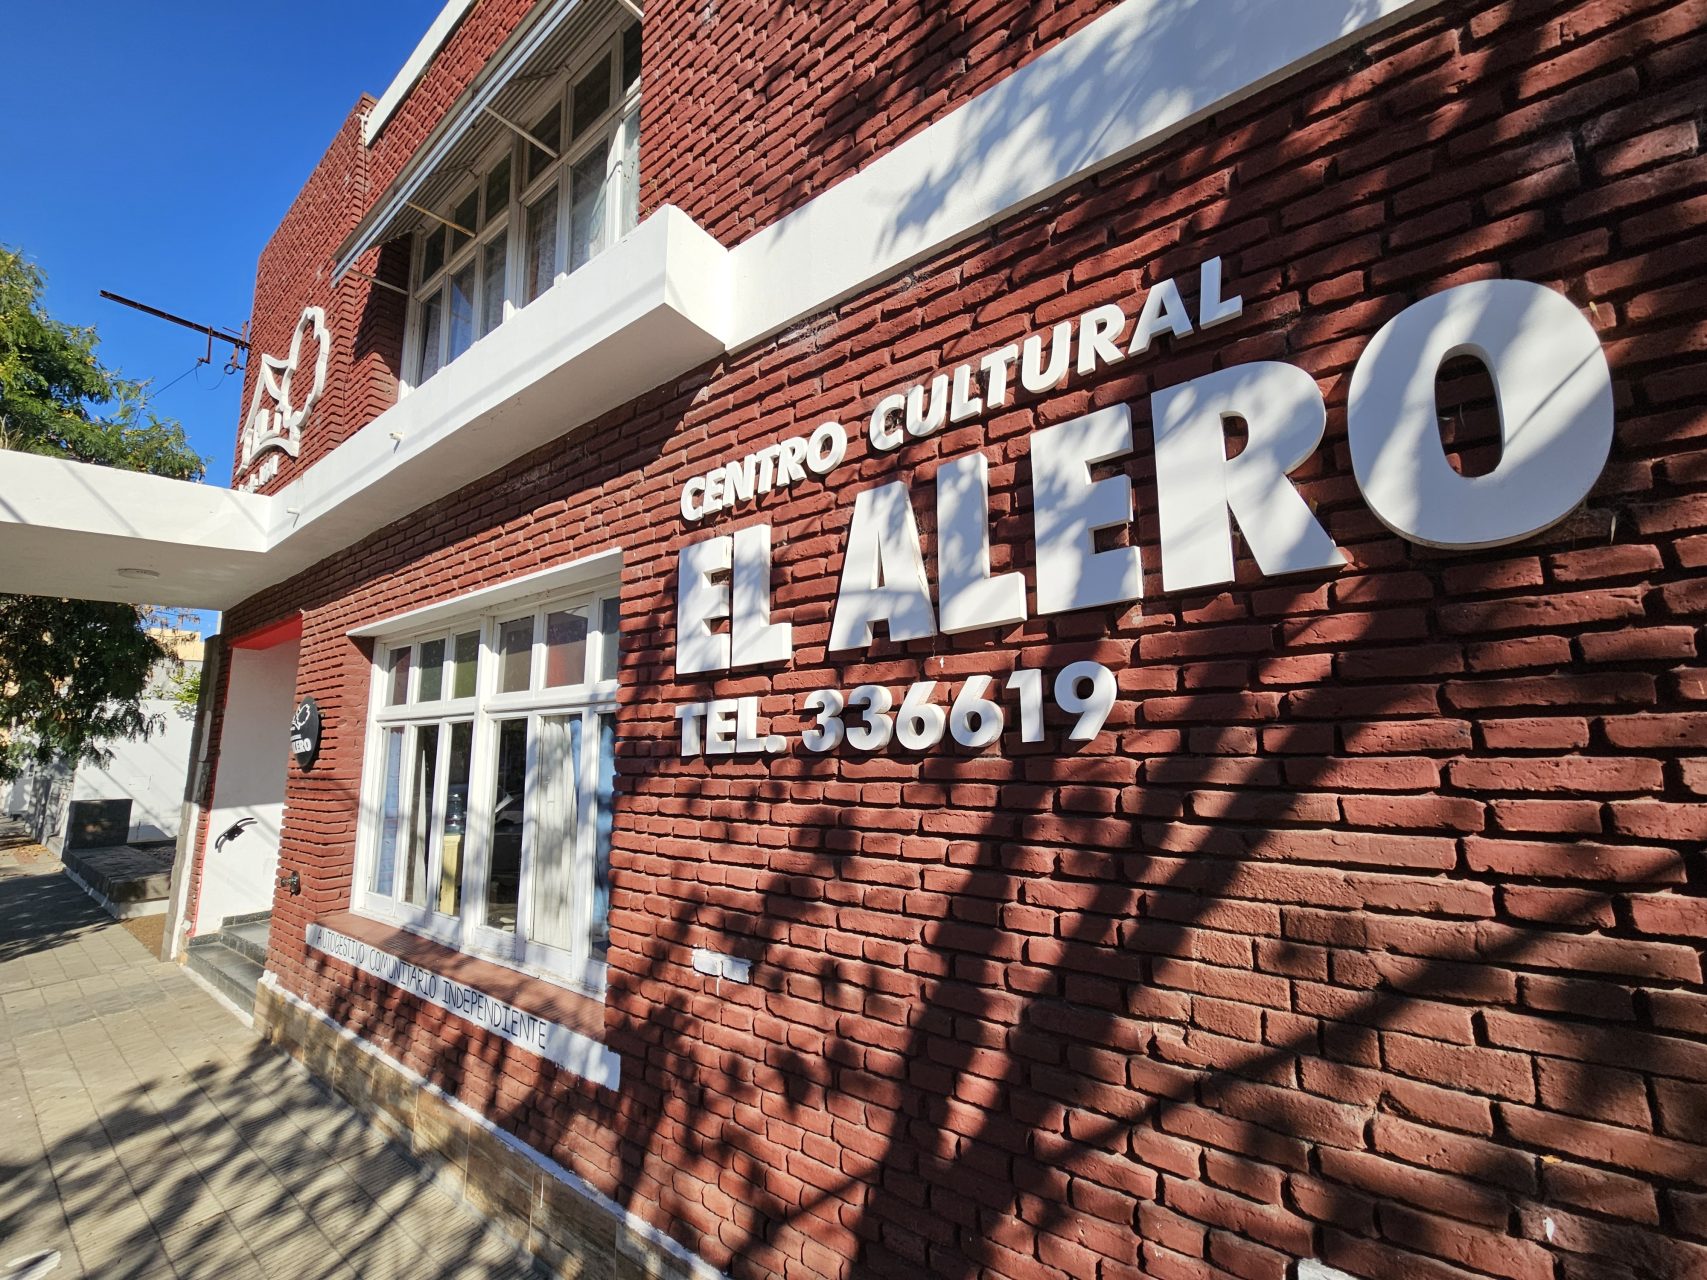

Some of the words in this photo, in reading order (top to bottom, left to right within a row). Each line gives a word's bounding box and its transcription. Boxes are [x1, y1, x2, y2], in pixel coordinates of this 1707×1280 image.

[675, 523, 793, 675] EL
[829, 278, 1615, 652] ALERO
[681, 421, 848, 521] CENTRO
[869, 256, 1243, 450] CULTURAL
[675, 695, 788, 757] TEL.
[802, 660, 1118, 753] 336619
[316, 928, 366, 964] AUTOGESTIVO
[369, 949, 437, 999] COMUNITARIO
[441, 979, 548, 1050] INDEPENDIENTE
